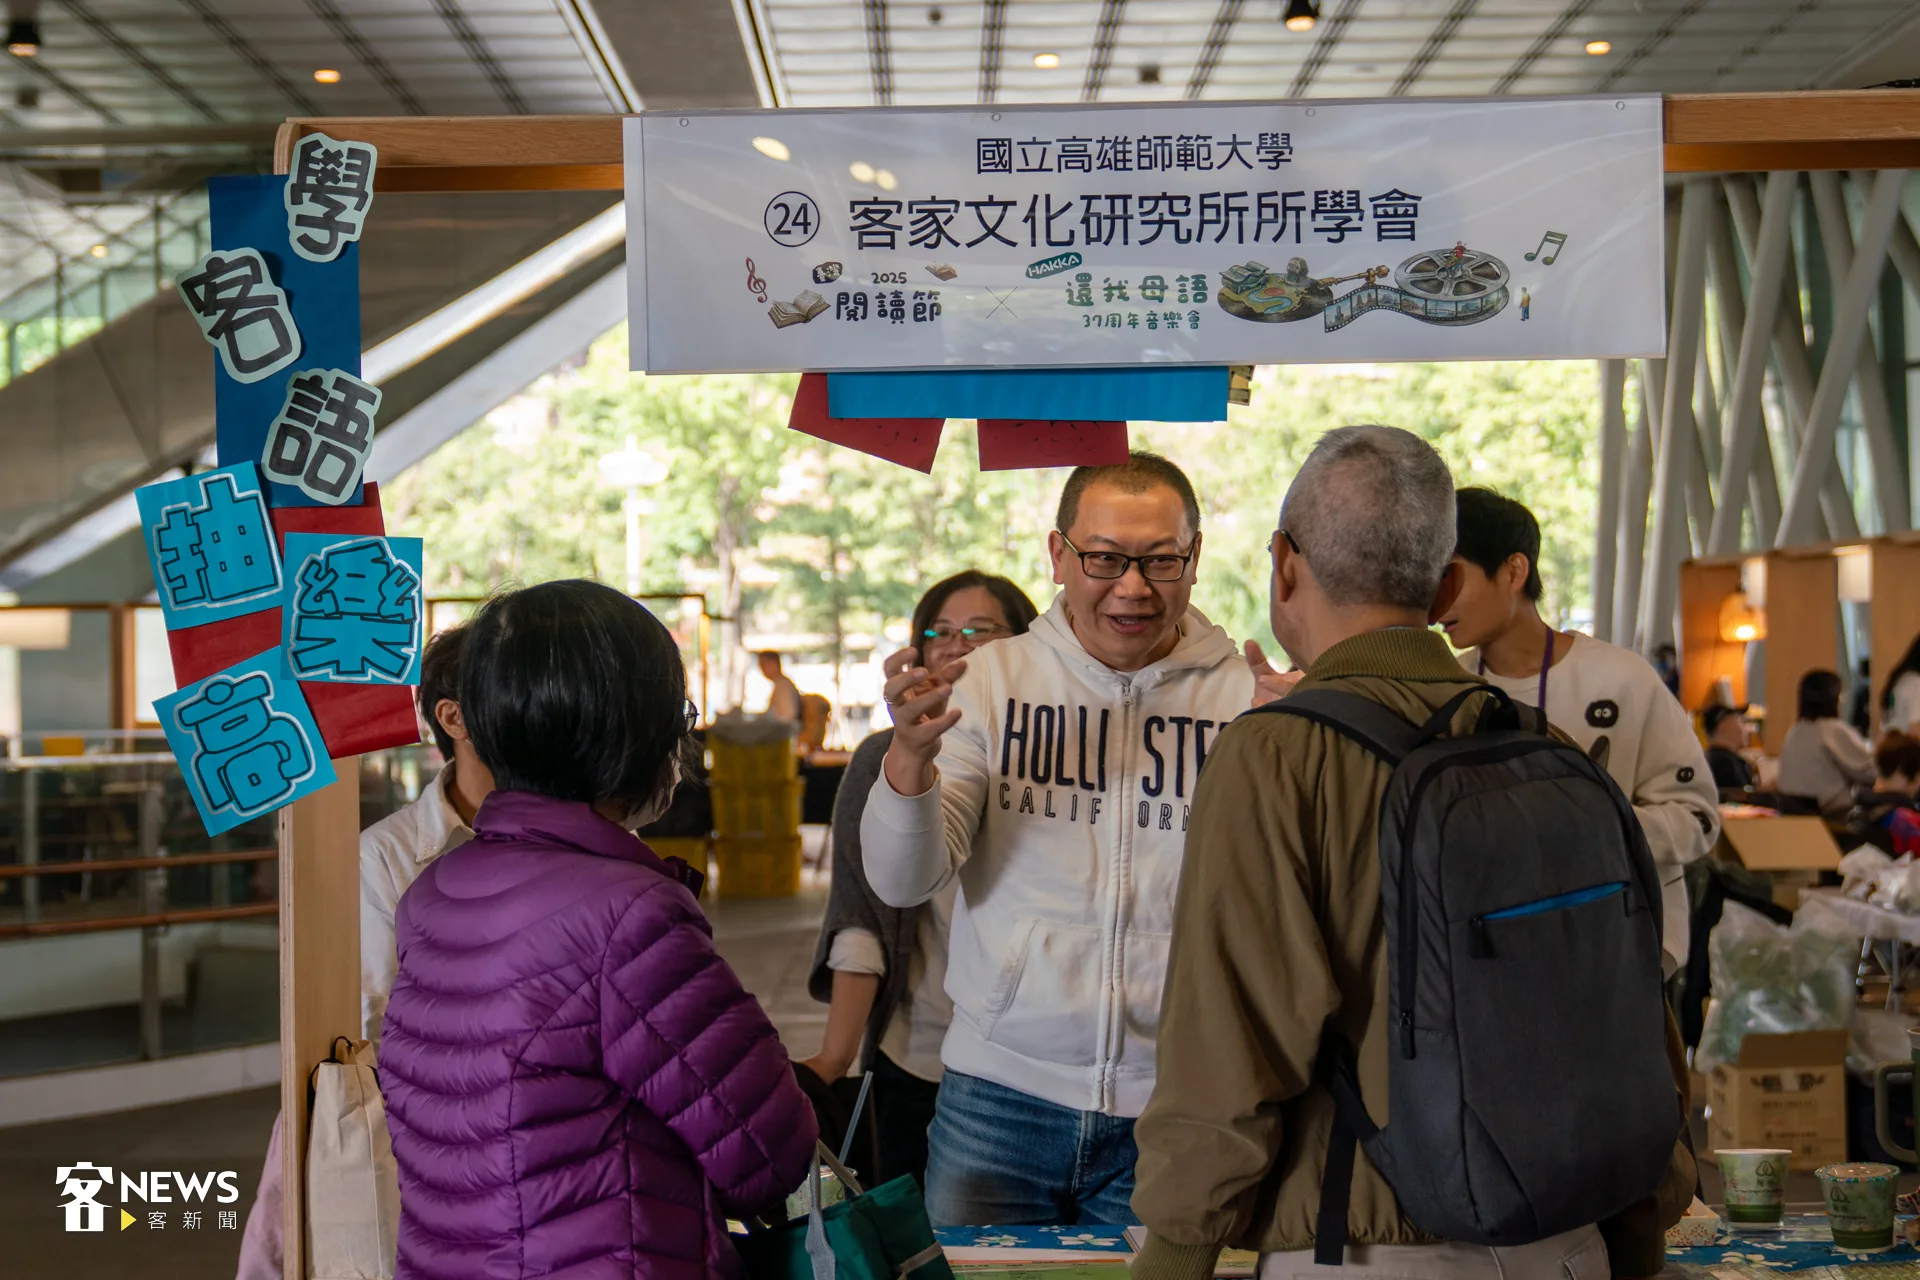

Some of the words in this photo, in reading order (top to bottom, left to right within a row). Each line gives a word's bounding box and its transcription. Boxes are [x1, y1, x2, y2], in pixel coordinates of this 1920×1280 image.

[976, 132, 1293, 174] 國立高雄師範大學
[849, 188, 1422, 250] 客家文化研究所所學會
[871, 272, 908, 285] 2025
[1027, 255, 1080, 278] HAKKA
[835, 290, 943, 325] 閱讀節
[1065, 272, 1209, 308] 還我母語
[1082, 309, 1201, 331] 37周年音樂會
